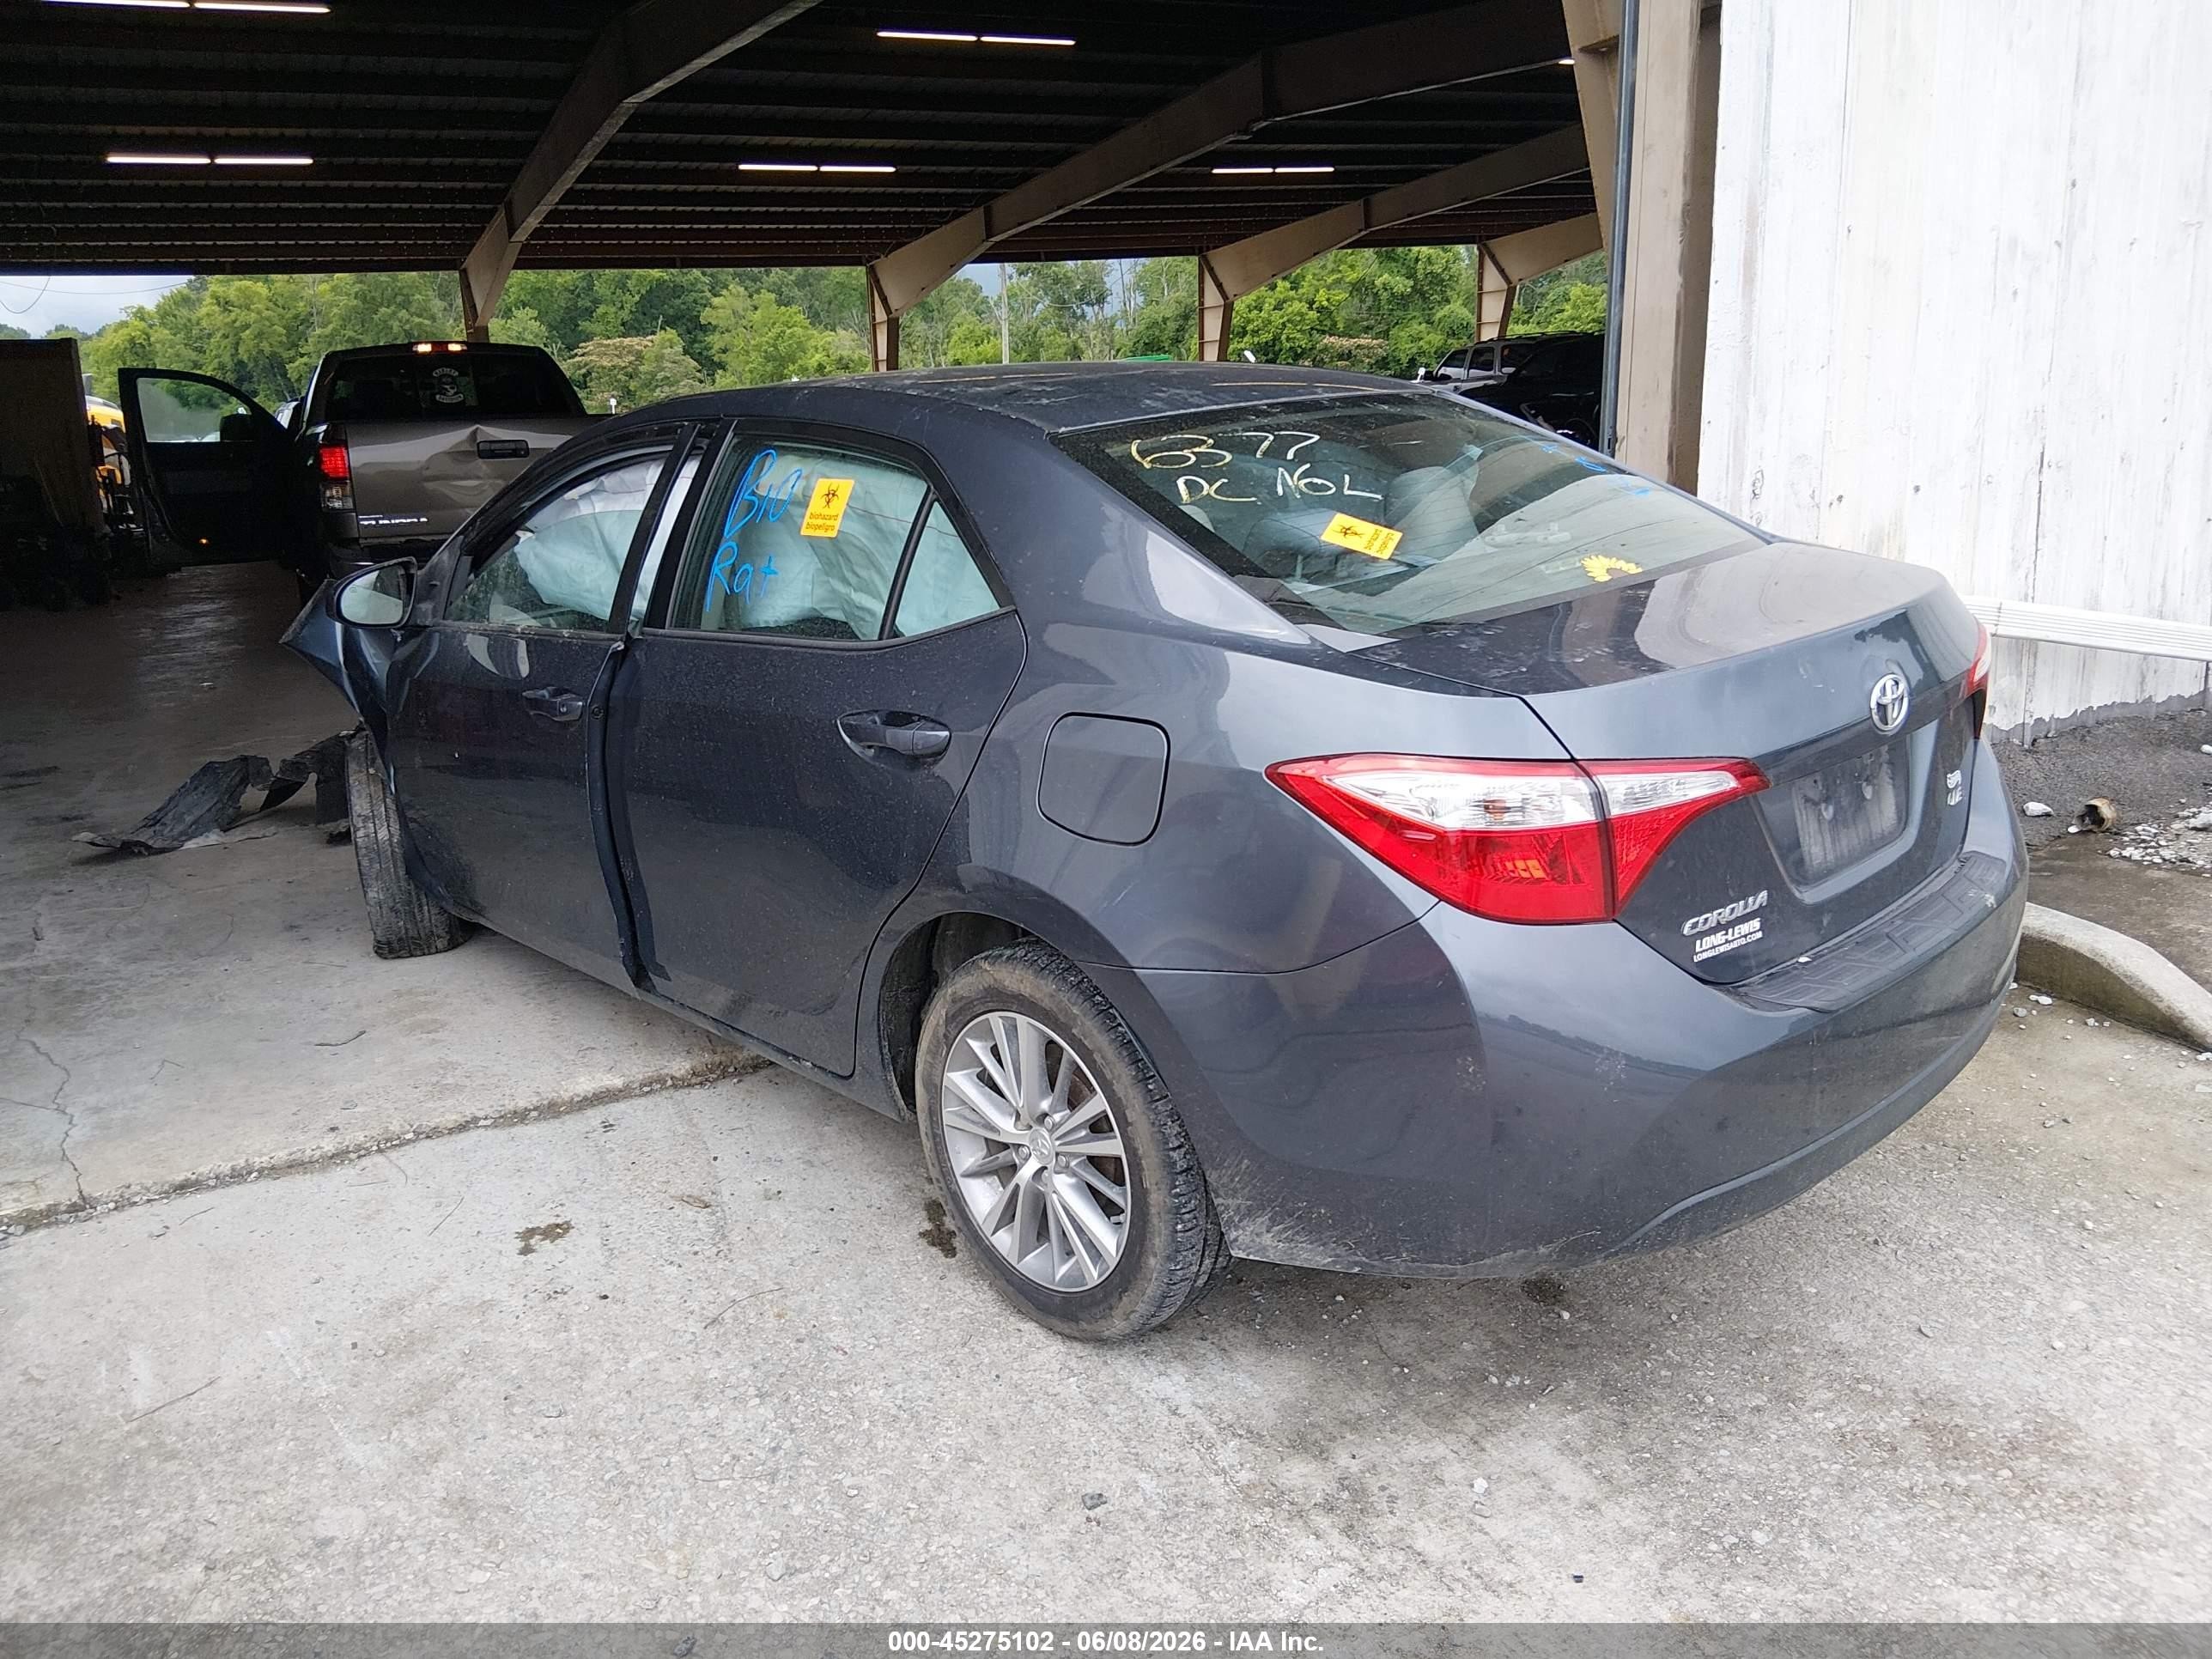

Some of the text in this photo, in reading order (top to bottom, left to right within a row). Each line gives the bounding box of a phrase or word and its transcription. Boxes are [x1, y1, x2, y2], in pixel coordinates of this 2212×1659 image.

[1130, 431, 1321, 470] 6377
[1176, 475, 1258, 504] DC
[805, 522, 836, 532] biopeligro
[809, 512, 839, 521] biohazard
[1680, 890, 1769, 937] COROLLA
[1695, 917, 1761, 953] LONG-LEWIS
